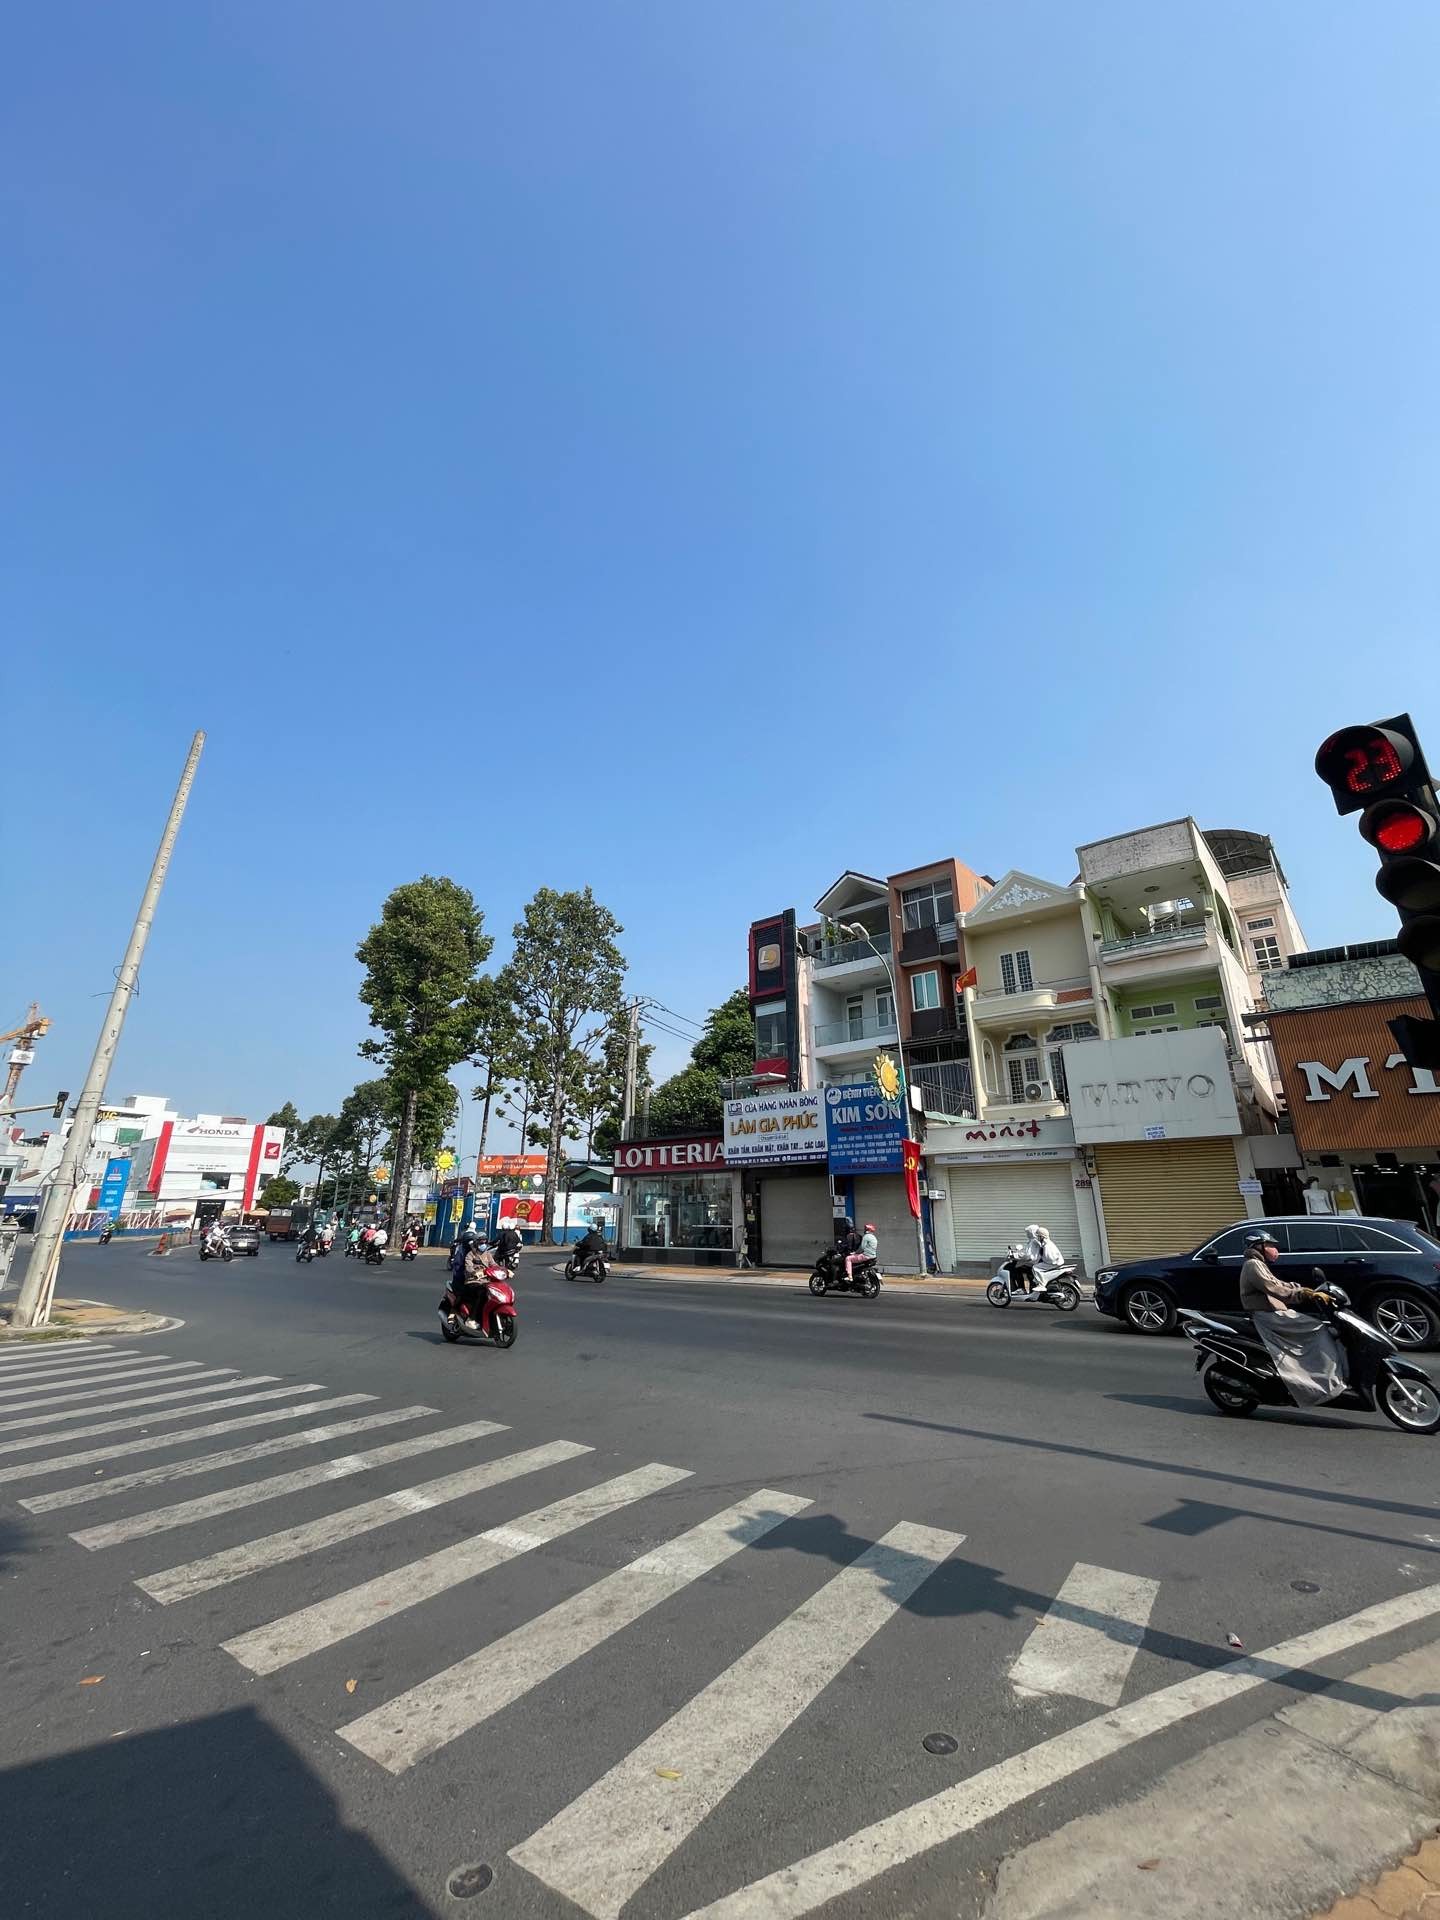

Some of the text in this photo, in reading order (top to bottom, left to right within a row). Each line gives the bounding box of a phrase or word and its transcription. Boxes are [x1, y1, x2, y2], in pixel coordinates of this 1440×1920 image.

[1345, 738, 1402, 792] 23
[729, 1118, 757, 1136] LÂM
[759, 1116, 780, 1133] GIA
[782, 1110, 818, 1131] PHÚC
[832, 1105, 861, 1124] KIM
[199, 1128, 240, 1137] HONDA
[614, 1142, 725, 1168] LOTTERIA
